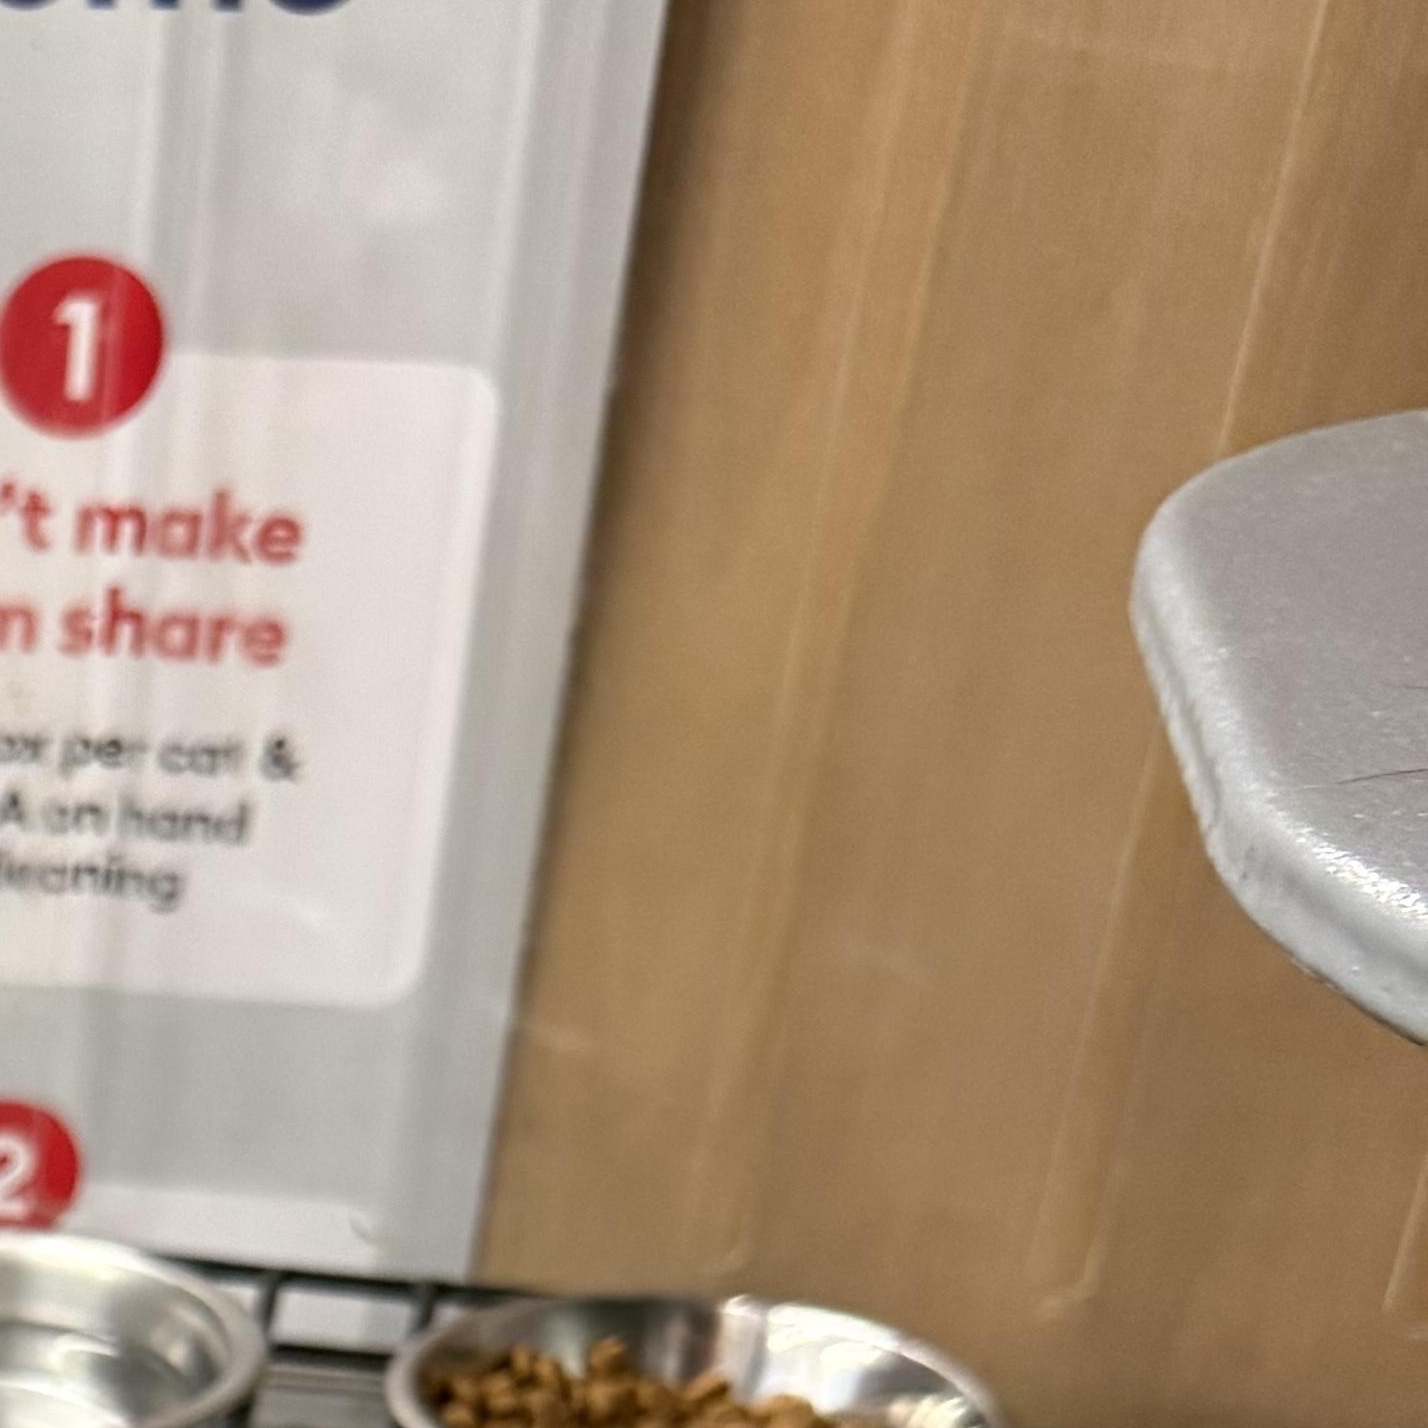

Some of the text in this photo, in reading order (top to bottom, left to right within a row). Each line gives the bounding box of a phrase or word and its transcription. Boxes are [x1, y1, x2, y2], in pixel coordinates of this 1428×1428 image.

[52, 292, 104, 404] 1
[74, 486, 303, 566] make
[58, 582, 286, 667] share
[60, 734, 148, 781] per
[158, 738, 240, 777] cat
[260, 733, 301, 783] &
[42, 798, 108, 835] on
[118, 800, 250, 847] hand
